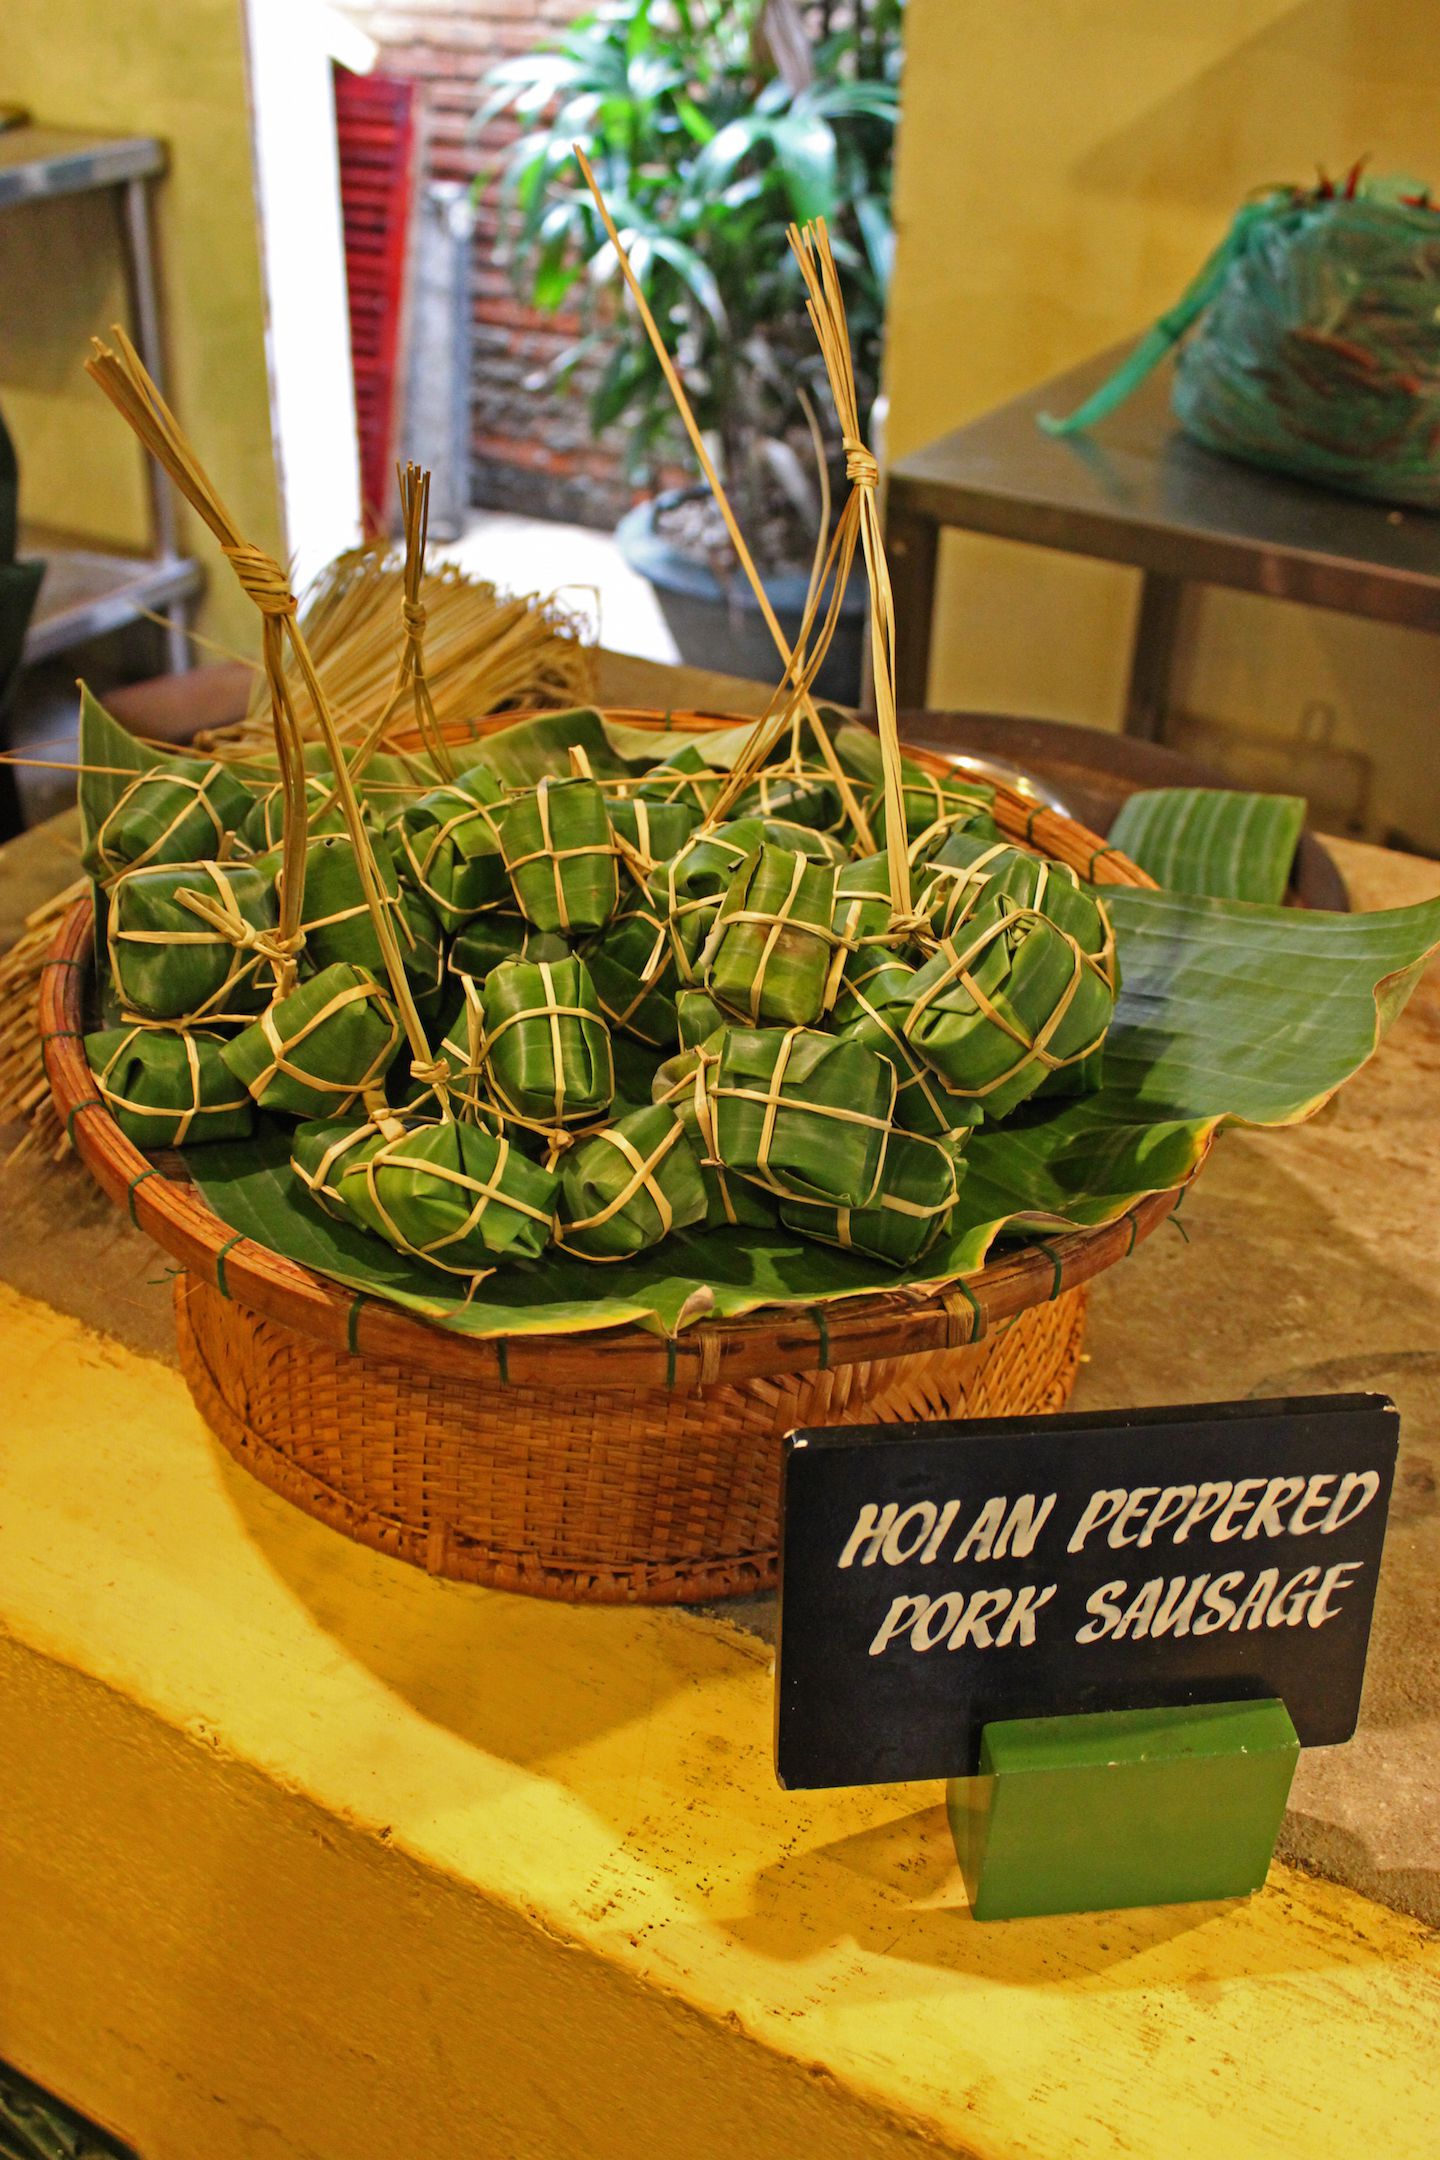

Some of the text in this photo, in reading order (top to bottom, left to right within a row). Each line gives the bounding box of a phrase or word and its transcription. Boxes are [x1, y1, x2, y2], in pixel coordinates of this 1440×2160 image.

[838, 1470, 1380, 1569] HOI AN PEPPERED
[868, 1561, 1364, 1656] PORK SAUSAGE
